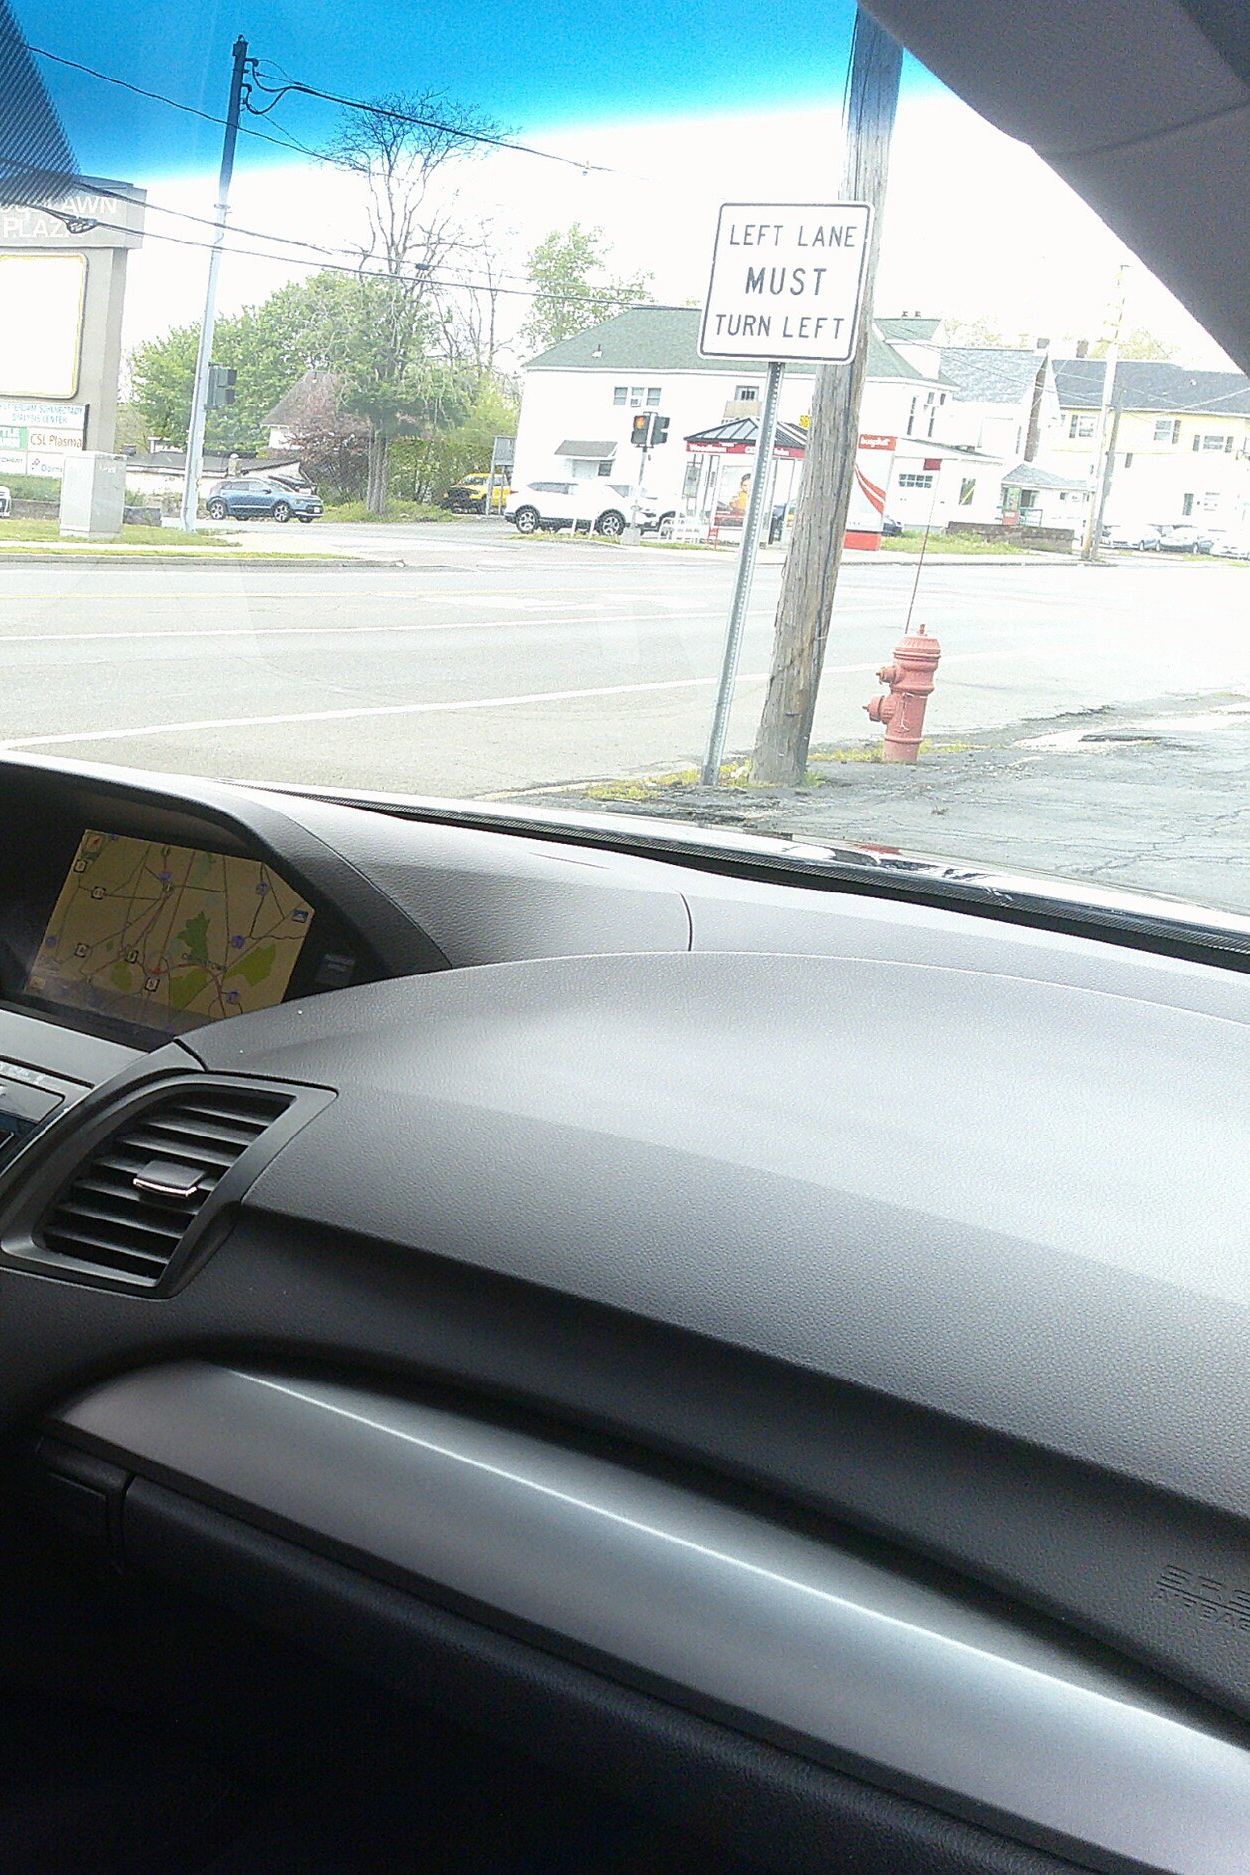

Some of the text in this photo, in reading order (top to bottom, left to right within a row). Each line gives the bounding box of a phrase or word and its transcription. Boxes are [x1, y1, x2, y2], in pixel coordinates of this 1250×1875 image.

[729, 224, 858, 248] LEFT LANE
[745, 266, 827, 296] MUST
[715, 313, 845, 340] TURN LEFT
[30, 433, 46, 446] CSL
[49, 434, 83, 448] Plasma
